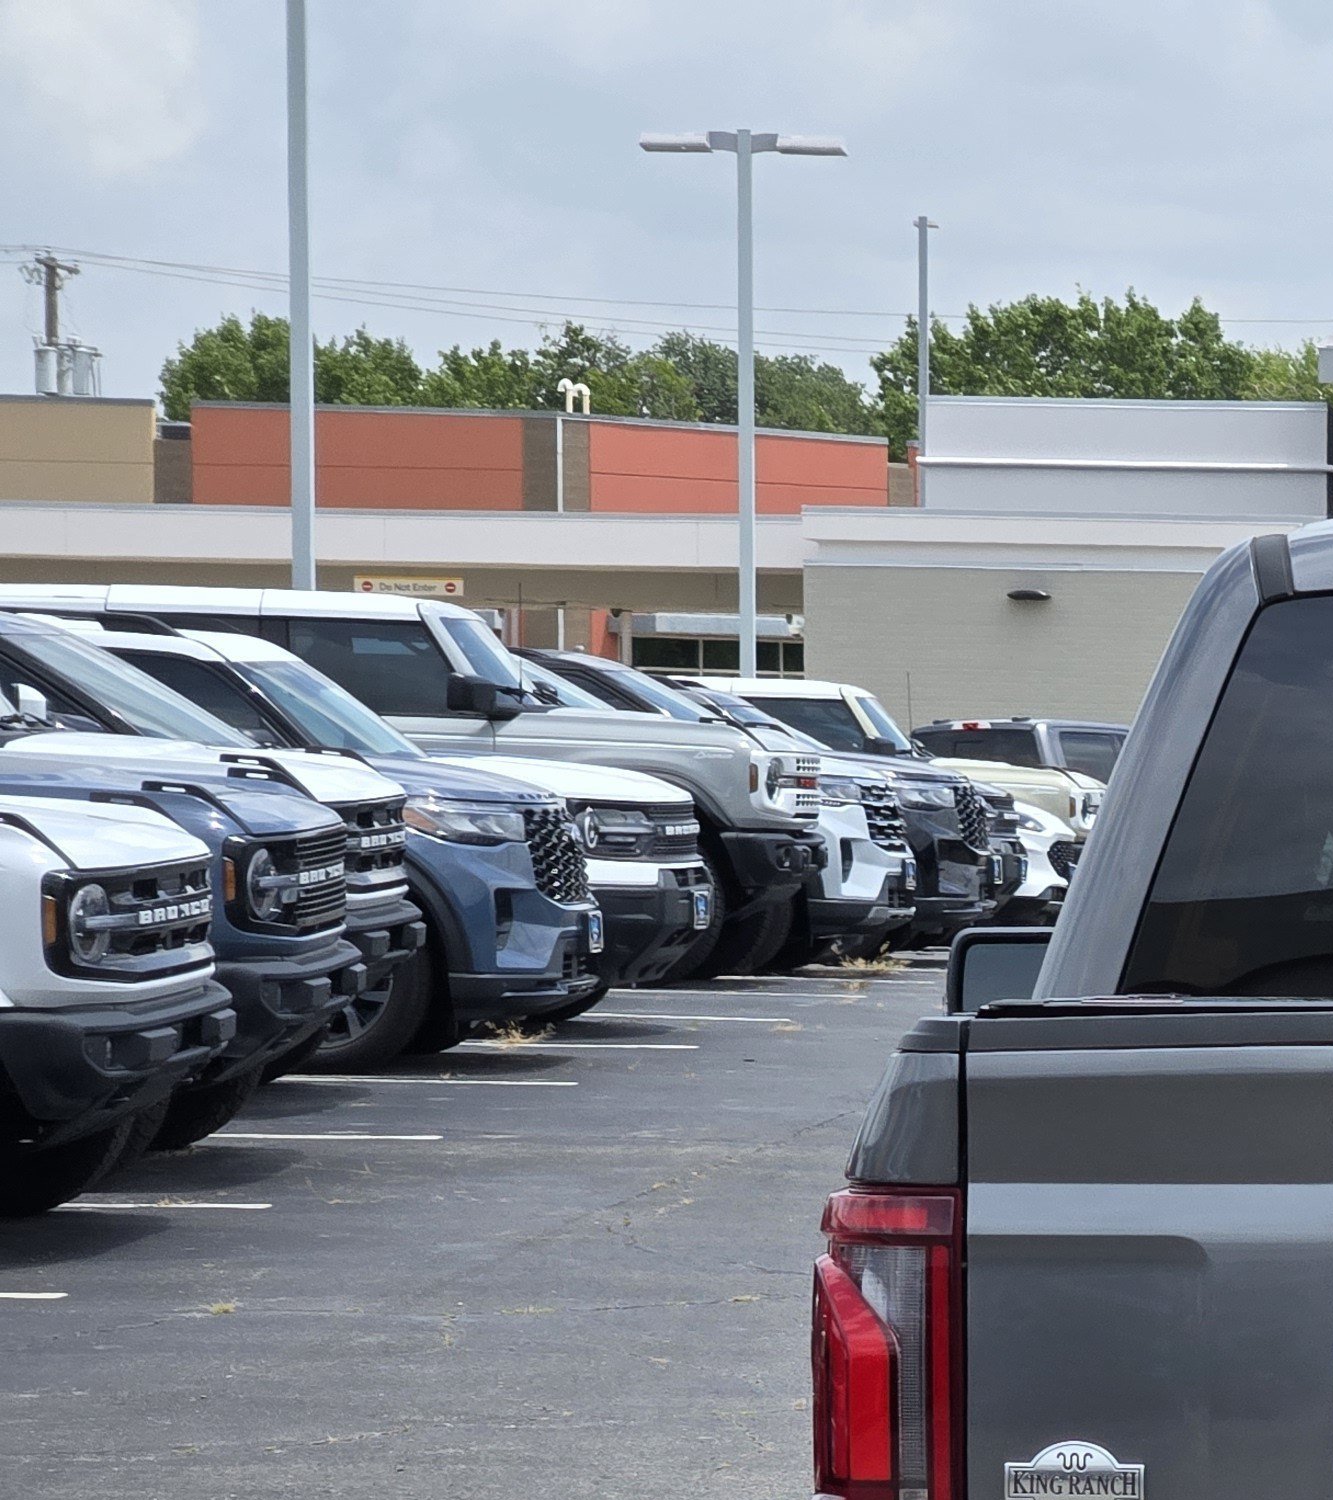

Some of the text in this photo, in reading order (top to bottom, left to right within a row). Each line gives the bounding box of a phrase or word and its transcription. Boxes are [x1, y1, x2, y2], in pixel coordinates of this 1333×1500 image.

[379, 582, 437, 592] Do Not Enter
[1012, 1470, 1137, 1497] KING RANCH
